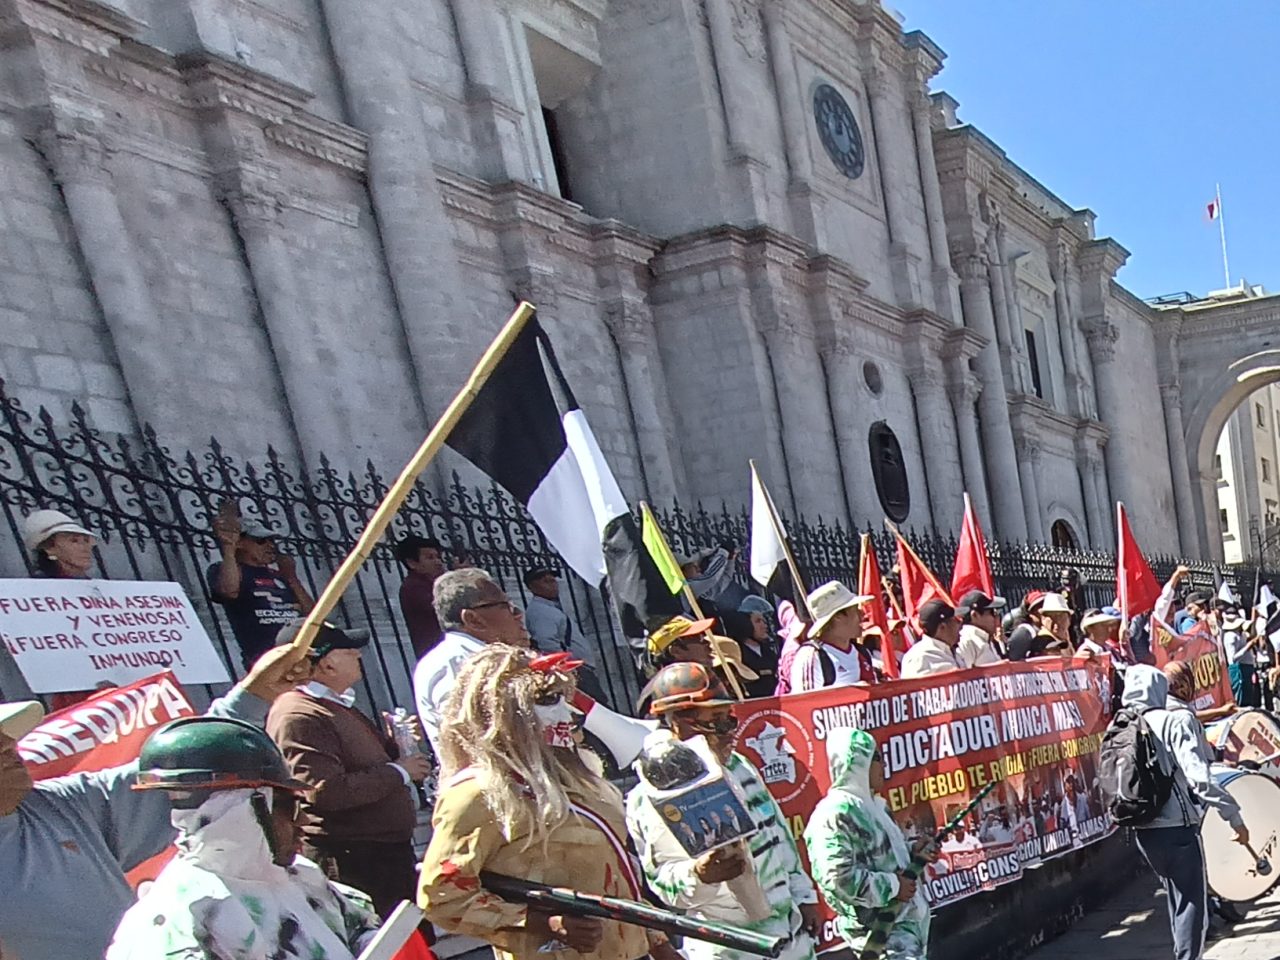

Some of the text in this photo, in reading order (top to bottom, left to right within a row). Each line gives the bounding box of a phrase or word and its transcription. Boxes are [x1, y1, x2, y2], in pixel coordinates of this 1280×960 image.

[0, 595, 186, 614] FUERA DINA ASESINA
[66, 610, 190, 631] Y VENENOSA!
[3, 629, 183, 654] ¡FUERA CONGRESO
[812, 698, 890, 740] SINDICATO
[892, 694, 909, 723] DE
[910, 677, 989, 718] TRABAJADORE
[882, 713, 999, 778] ¡DICTADUR
[1002, 704, 1052, 742] NUNCA
[888, 786, 908, 812] EL
[912, 769, 966, 804] PUEBLO
[967, 764, 988, 788] TE
